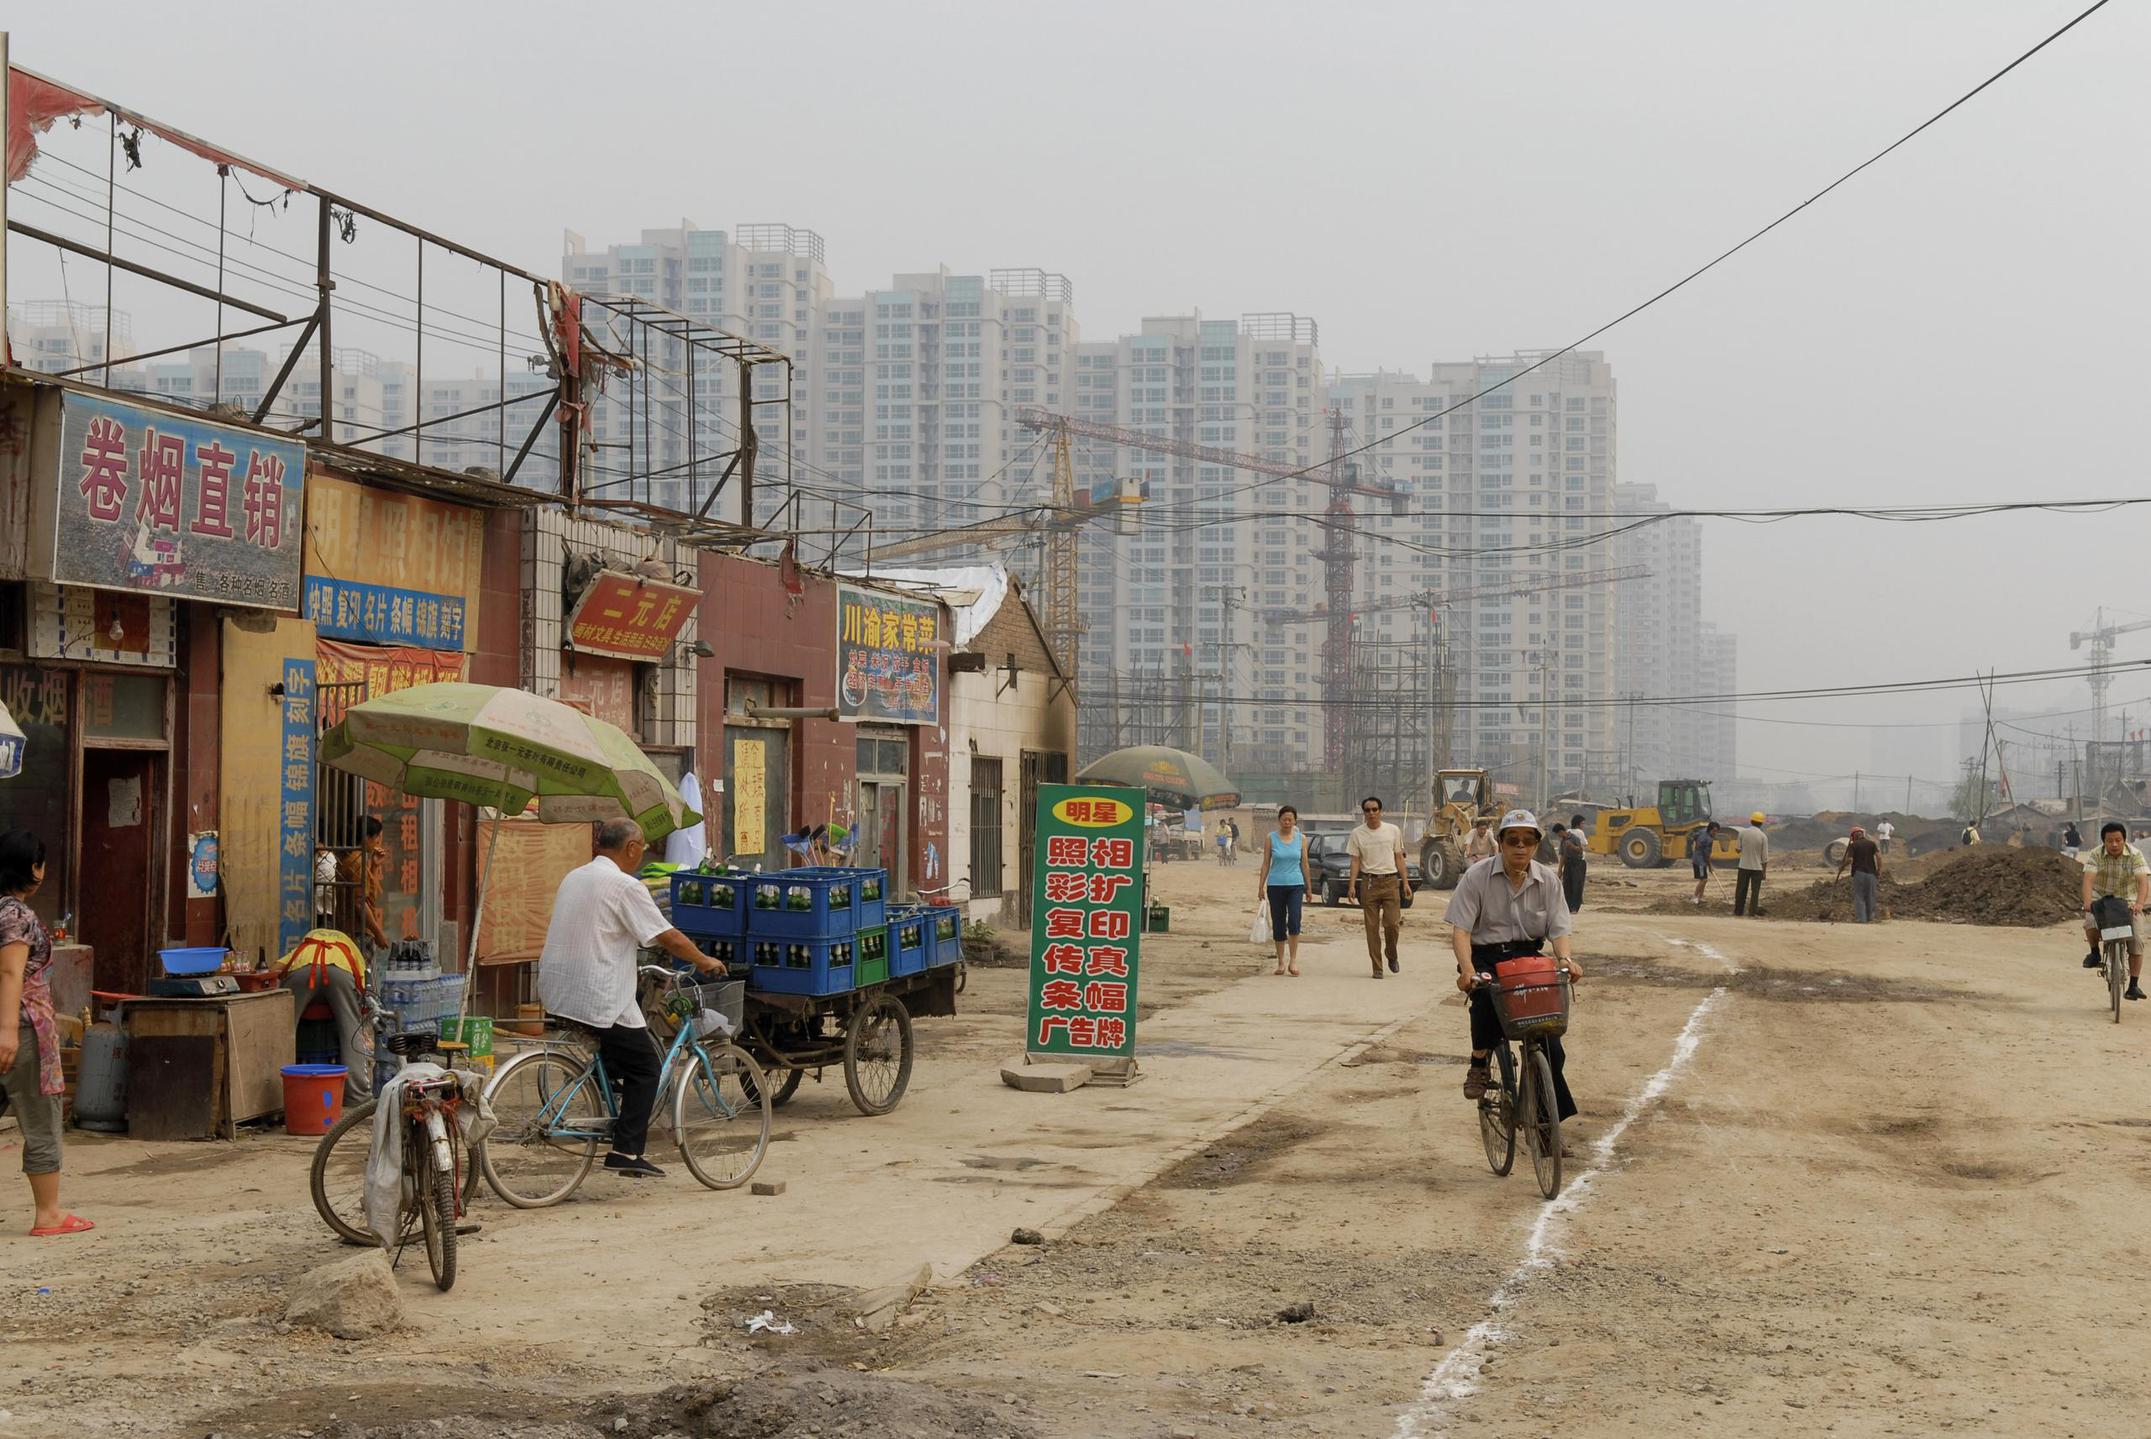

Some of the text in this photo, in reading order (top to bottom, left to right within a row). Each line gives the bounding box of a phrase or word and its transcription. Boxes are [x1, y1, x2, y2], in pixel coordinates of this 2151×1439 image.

[79, 416, 286, 550] 卷烟直销
[220, 574, 265, 597] 各种名烟
[309, 582, 334, 625] 快照
[336, 587, 361, 629] 复印
[364, 591, 387, 633] 名片
[391, 594, 414, 635] 条幅
[416, 598, 438, 639] 锦旗
[603, 588, 682, 630] 二元店
[843, 604, 935, 655] 川渝家常菜
[6, 670, 68, 726] 收烟
[286, 667, 312, 725] 刻字
[285, 733, 310, 792] 锦旗
[284, 800, 309, 858] 条幅
[1066, 801, 1118, 823] 明星
[1047, 837, 1133, 868] 照相
[283, 872, 308, 924] 名片
[1046, 873, 1133, 904] 彩扩
[1046, 908, 1130, 939] 复印
[1042, 944, 1128, 977] 传真
[1041, 980, 1127, 1012] 条幅
[1038, 1016, 1126, 1048] 广告牌
